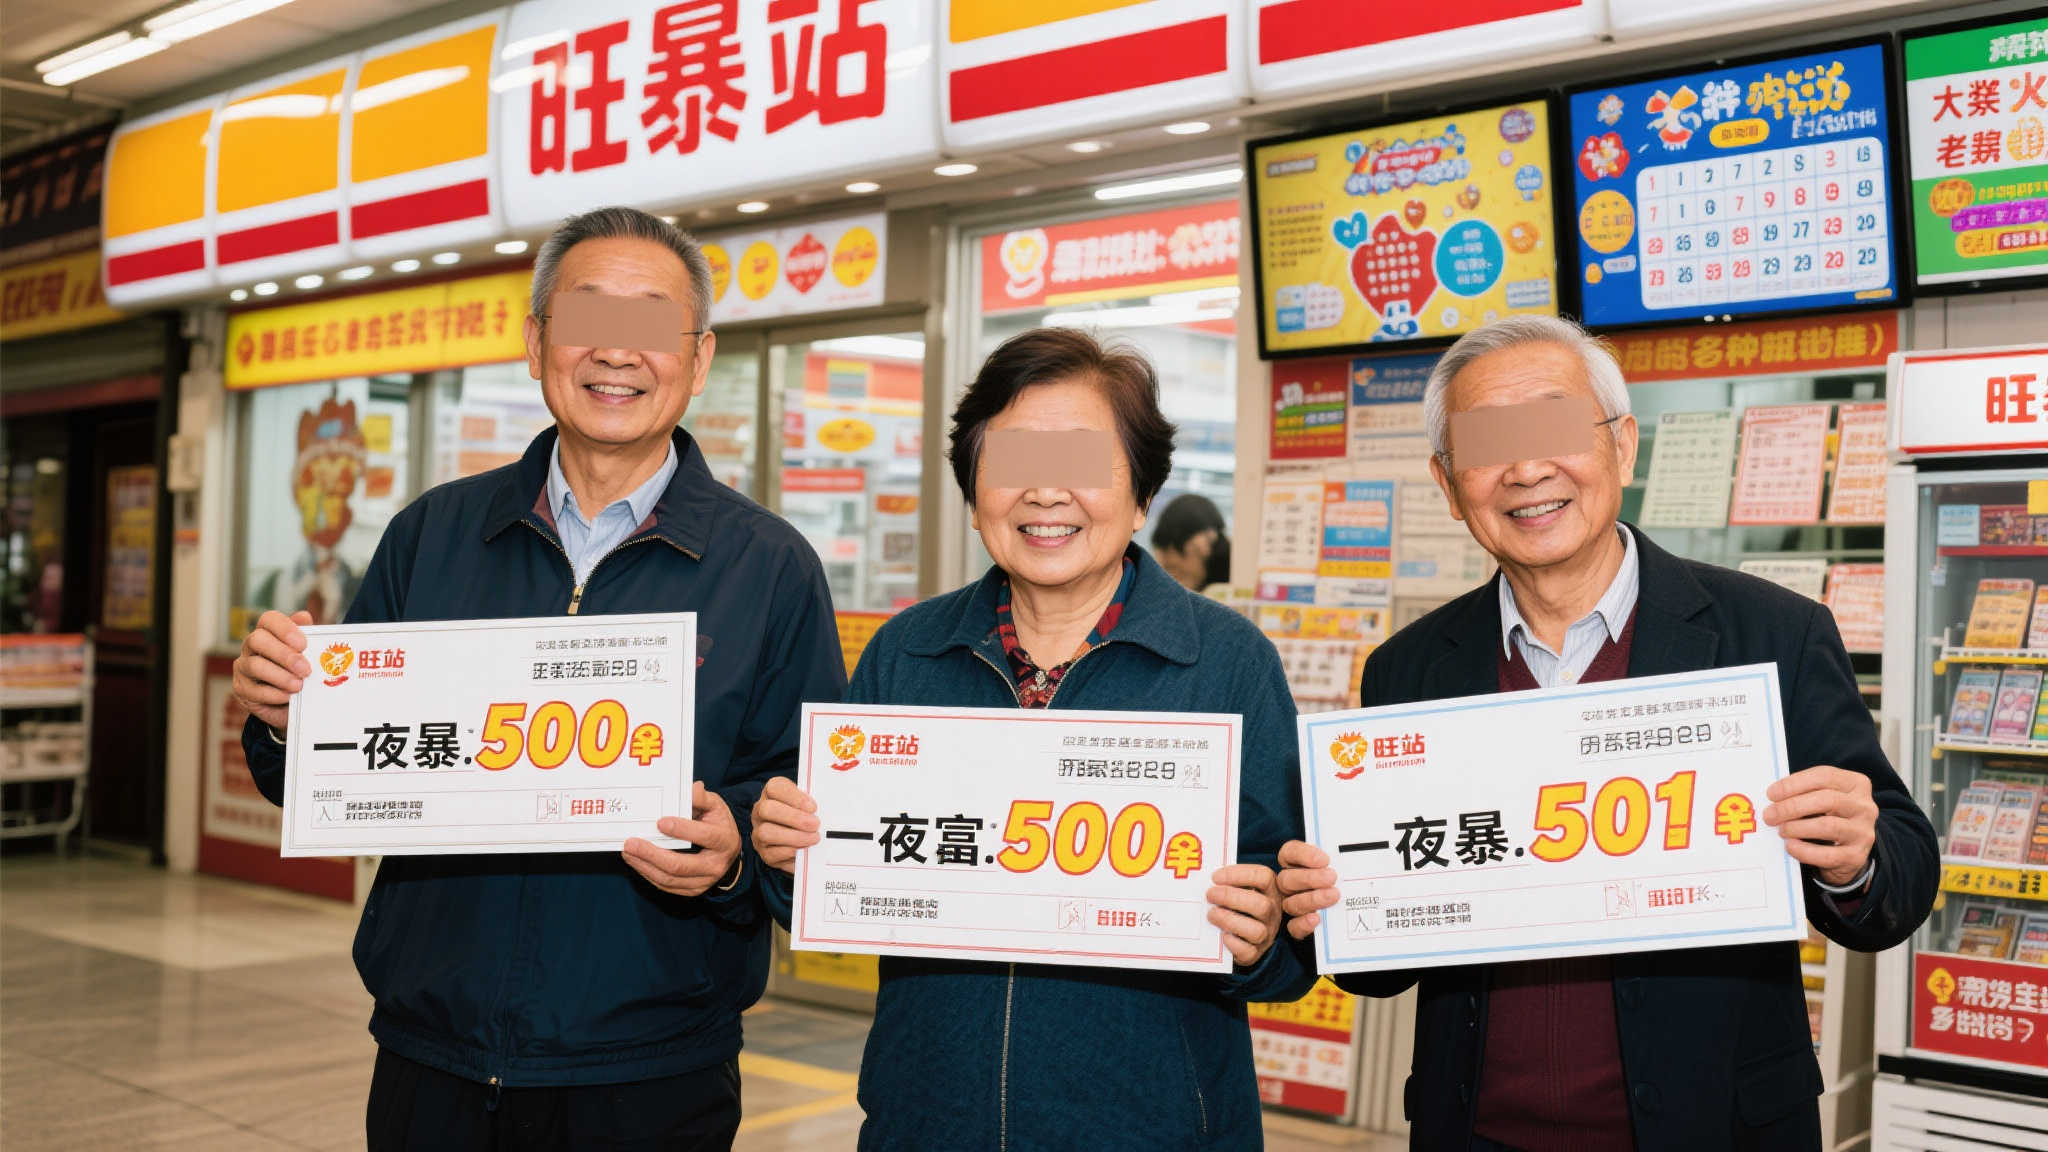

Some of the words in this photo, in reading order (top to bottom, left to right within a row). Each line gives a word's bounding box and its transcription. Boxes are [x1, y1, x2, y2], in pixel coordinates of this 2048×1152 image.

[530, 0, 887, 176] 旺暴站
[1986, 373, 2048, 424] 旺
[358, 648, 405, 670] 旺站
[475, 699, 629, 771] 500
[870, 734, 919, 756] 旺站
[1373, 733, 1426, 759] 旺站
[997, 799, 1165, 878] 500
